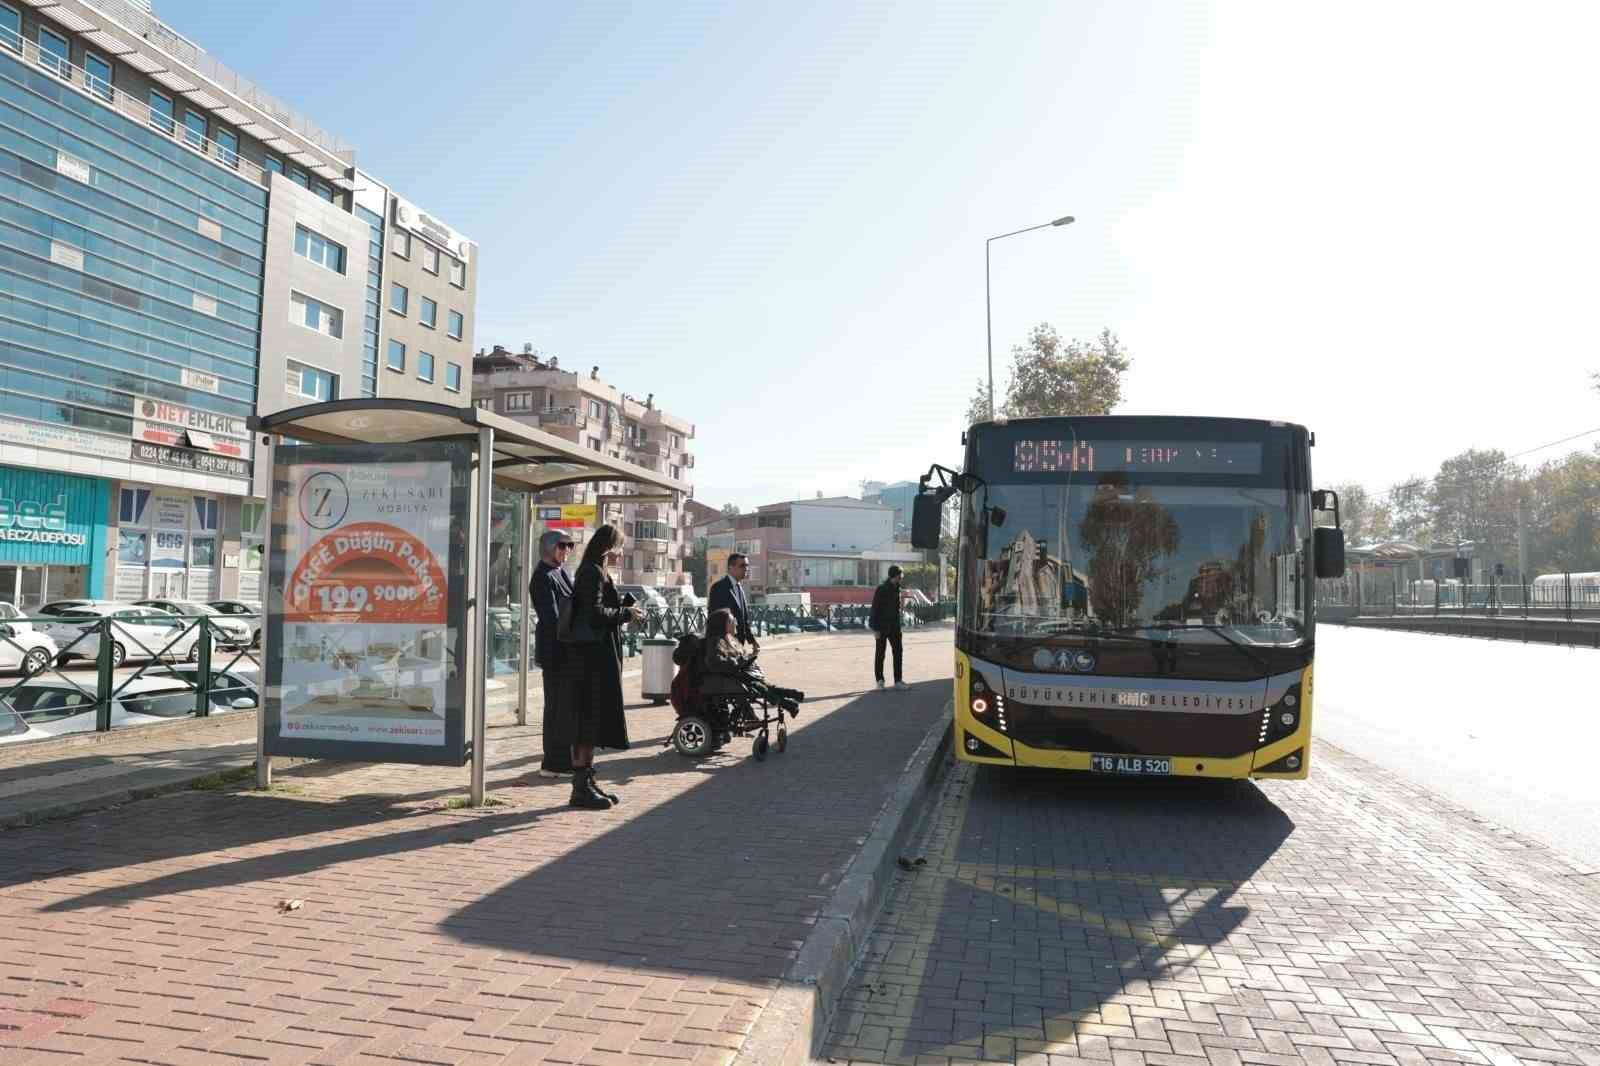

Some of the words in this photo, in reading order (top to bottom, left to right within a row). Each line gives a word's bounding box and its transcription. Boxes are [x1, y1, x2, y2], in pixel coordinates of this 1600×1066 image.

[157, 404, 186, 422] NET
[189, 411, 232, 432] EMLAK
[41, 532, 86, 545] DEPOSU
[335, 531, 394, 553] Düğün
[1101, 758, 1113, 770] 16
[1117, 758, 1142, 771] ALB
[1145, 760, 1169, 773] 520
